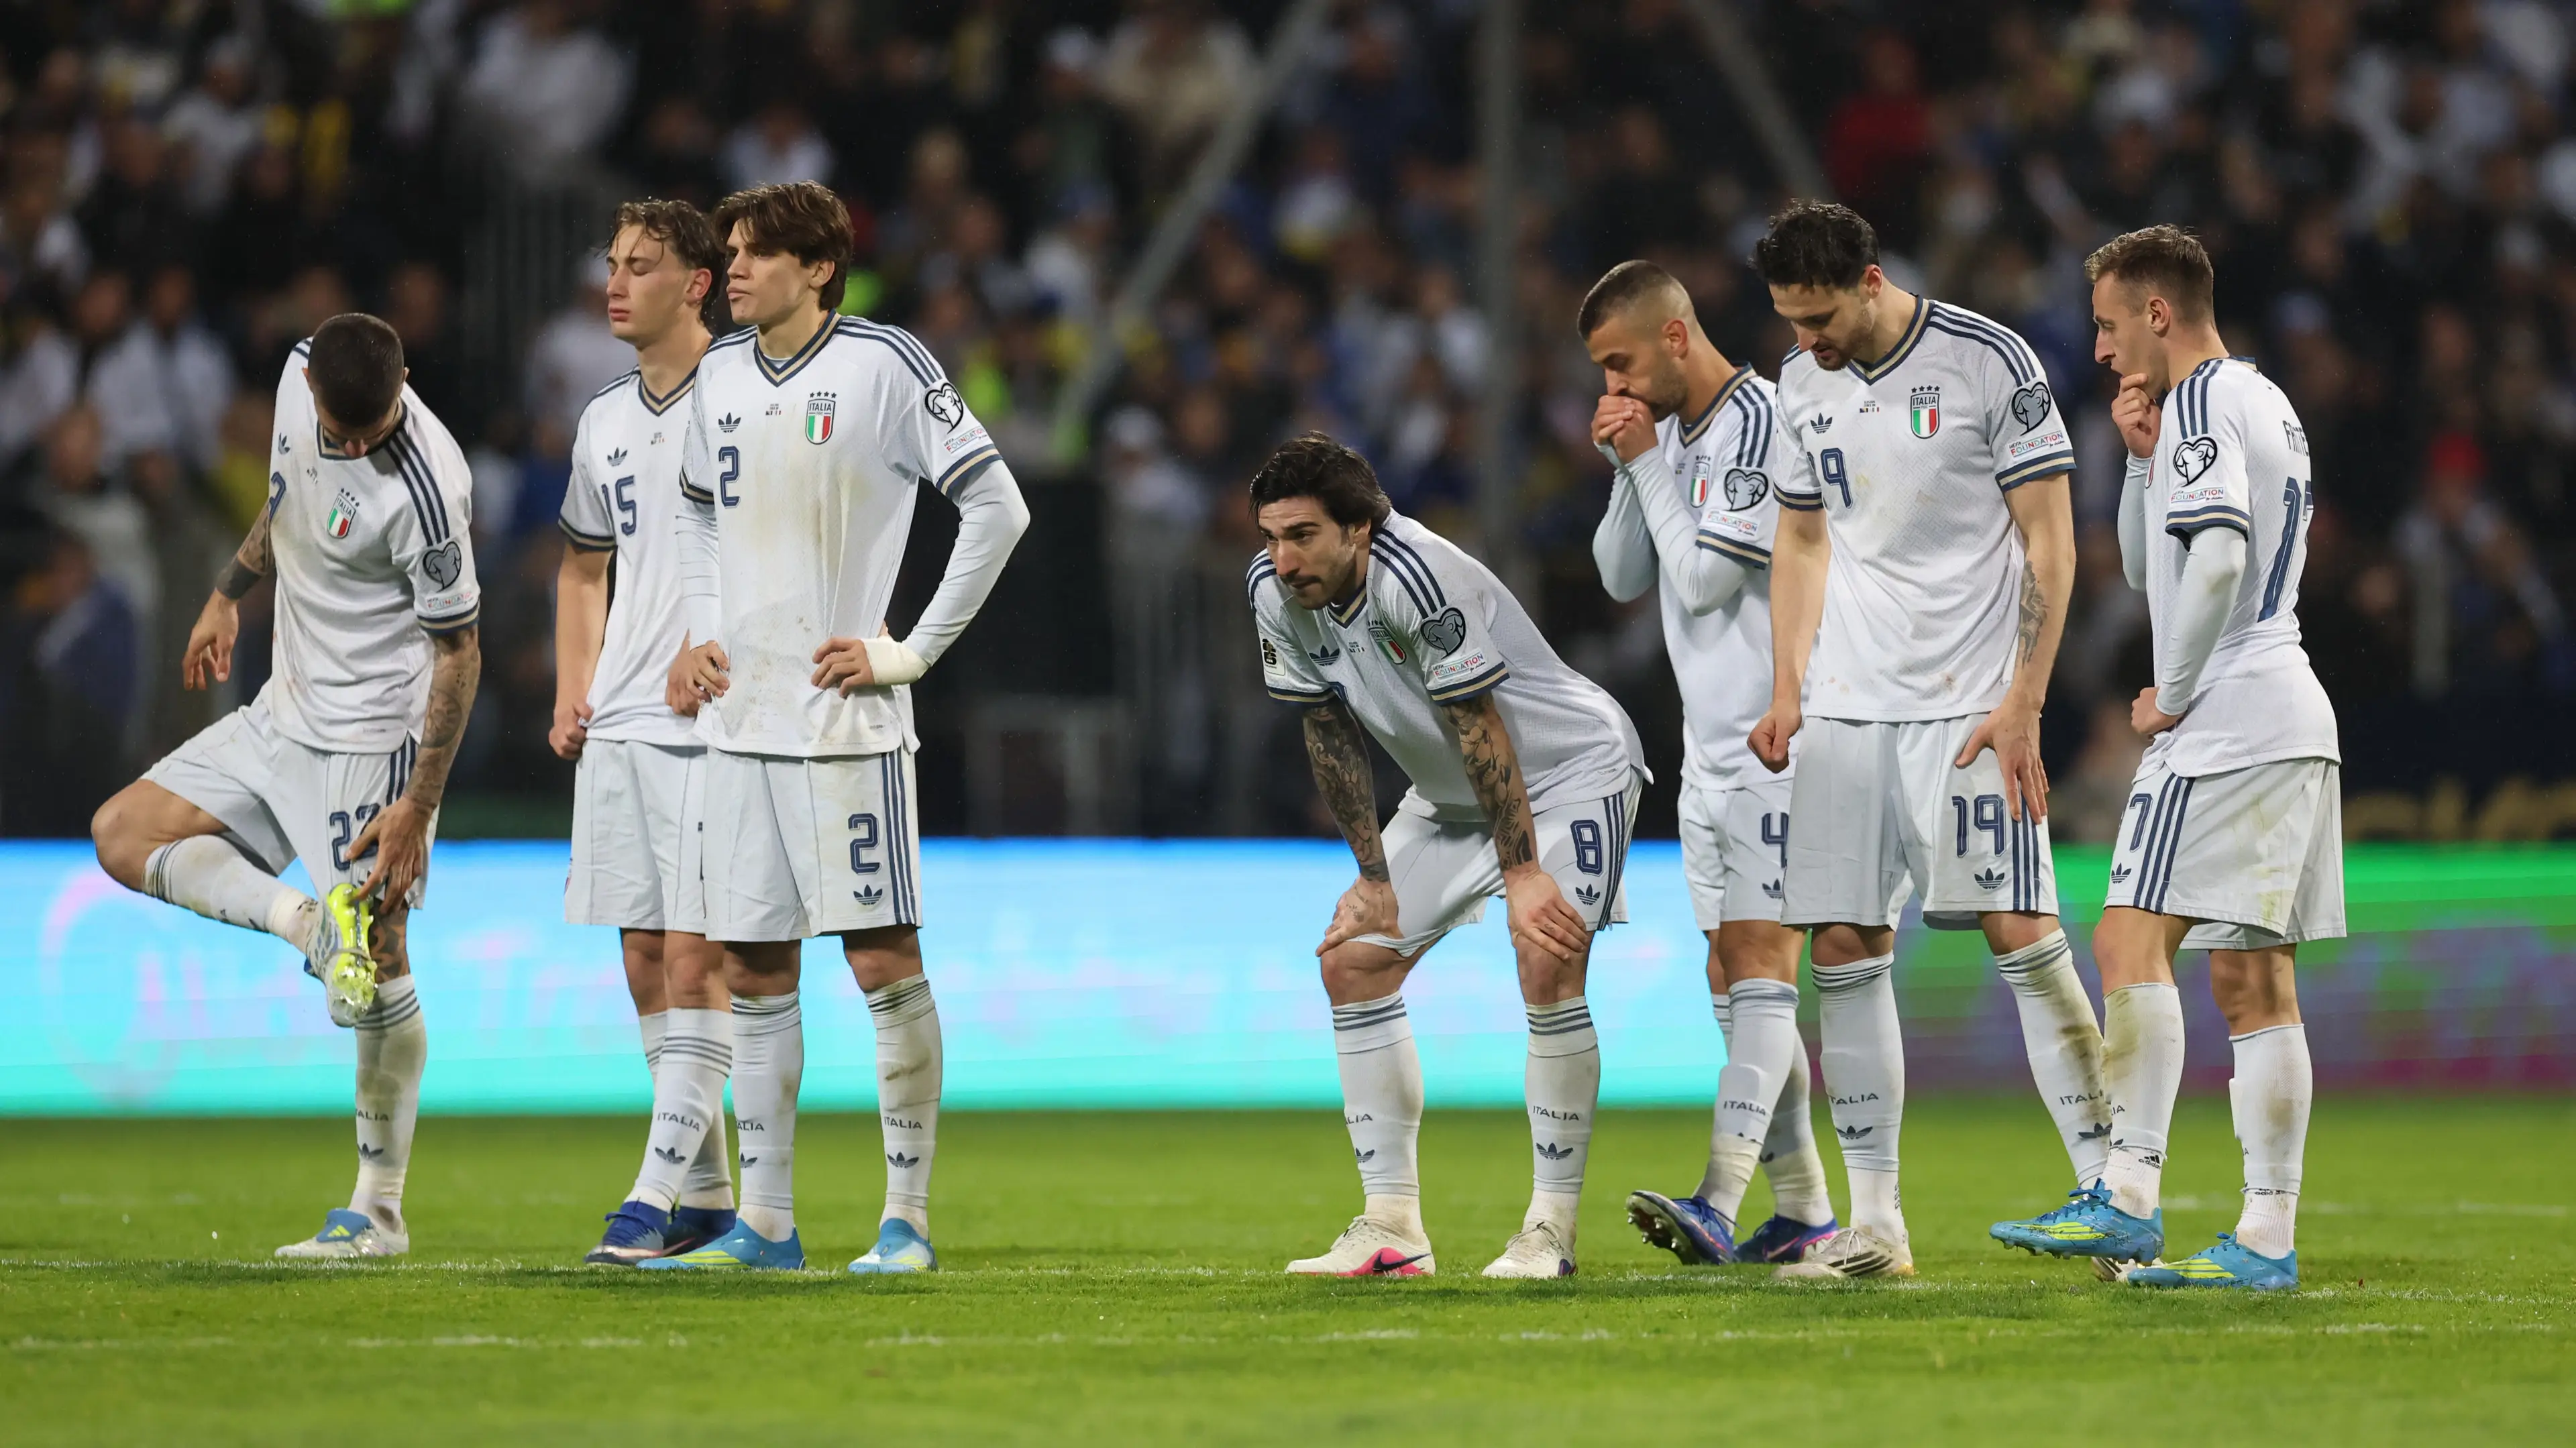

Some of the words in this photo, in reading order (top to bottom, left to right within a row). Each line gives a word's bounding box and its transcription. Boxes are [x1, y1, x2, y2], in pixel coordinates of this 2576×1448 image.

[809, 403, 832, 411] ITALIA
[1913, 396, 1937, 406] ITALIA
[2010, 433, 2063, 455] FOUNDATION
[718, 446, 741, 508] 2
[1807, 448, 1854, 508] 9
[601, 474, 637, 537] 15
[2171, 489, 2224, 502] FOUNDATION
[336, 497, 353, 517] ITALIA
[1435, 653, 1484, 677] FOUNDATION
[1951, 794, 2006, 857] 19
[2129, 793, 2153, 852] 7
[848, 813, 882, 875] 2
[1570, 820, 1603, 875] 8
[1761, 812, 1788, 868] 4
[1829, 1093, 1879, 1105] TALIA
[2059, 1089, 2103, 1105] ITALI
[356, 1109, 389, 1121] ALIA
[1346, 1113, 1373, 1124] LIA
[1532, 1105, 1580, 1121] ITALIA
[1723, 1101, 1766, 1117] ITALIA
[658, 1112, 700, 1132] ITALIA
[737, 1121, 765, 1131] ALIA
[883, 1116, 922, 1130] ITALIA
